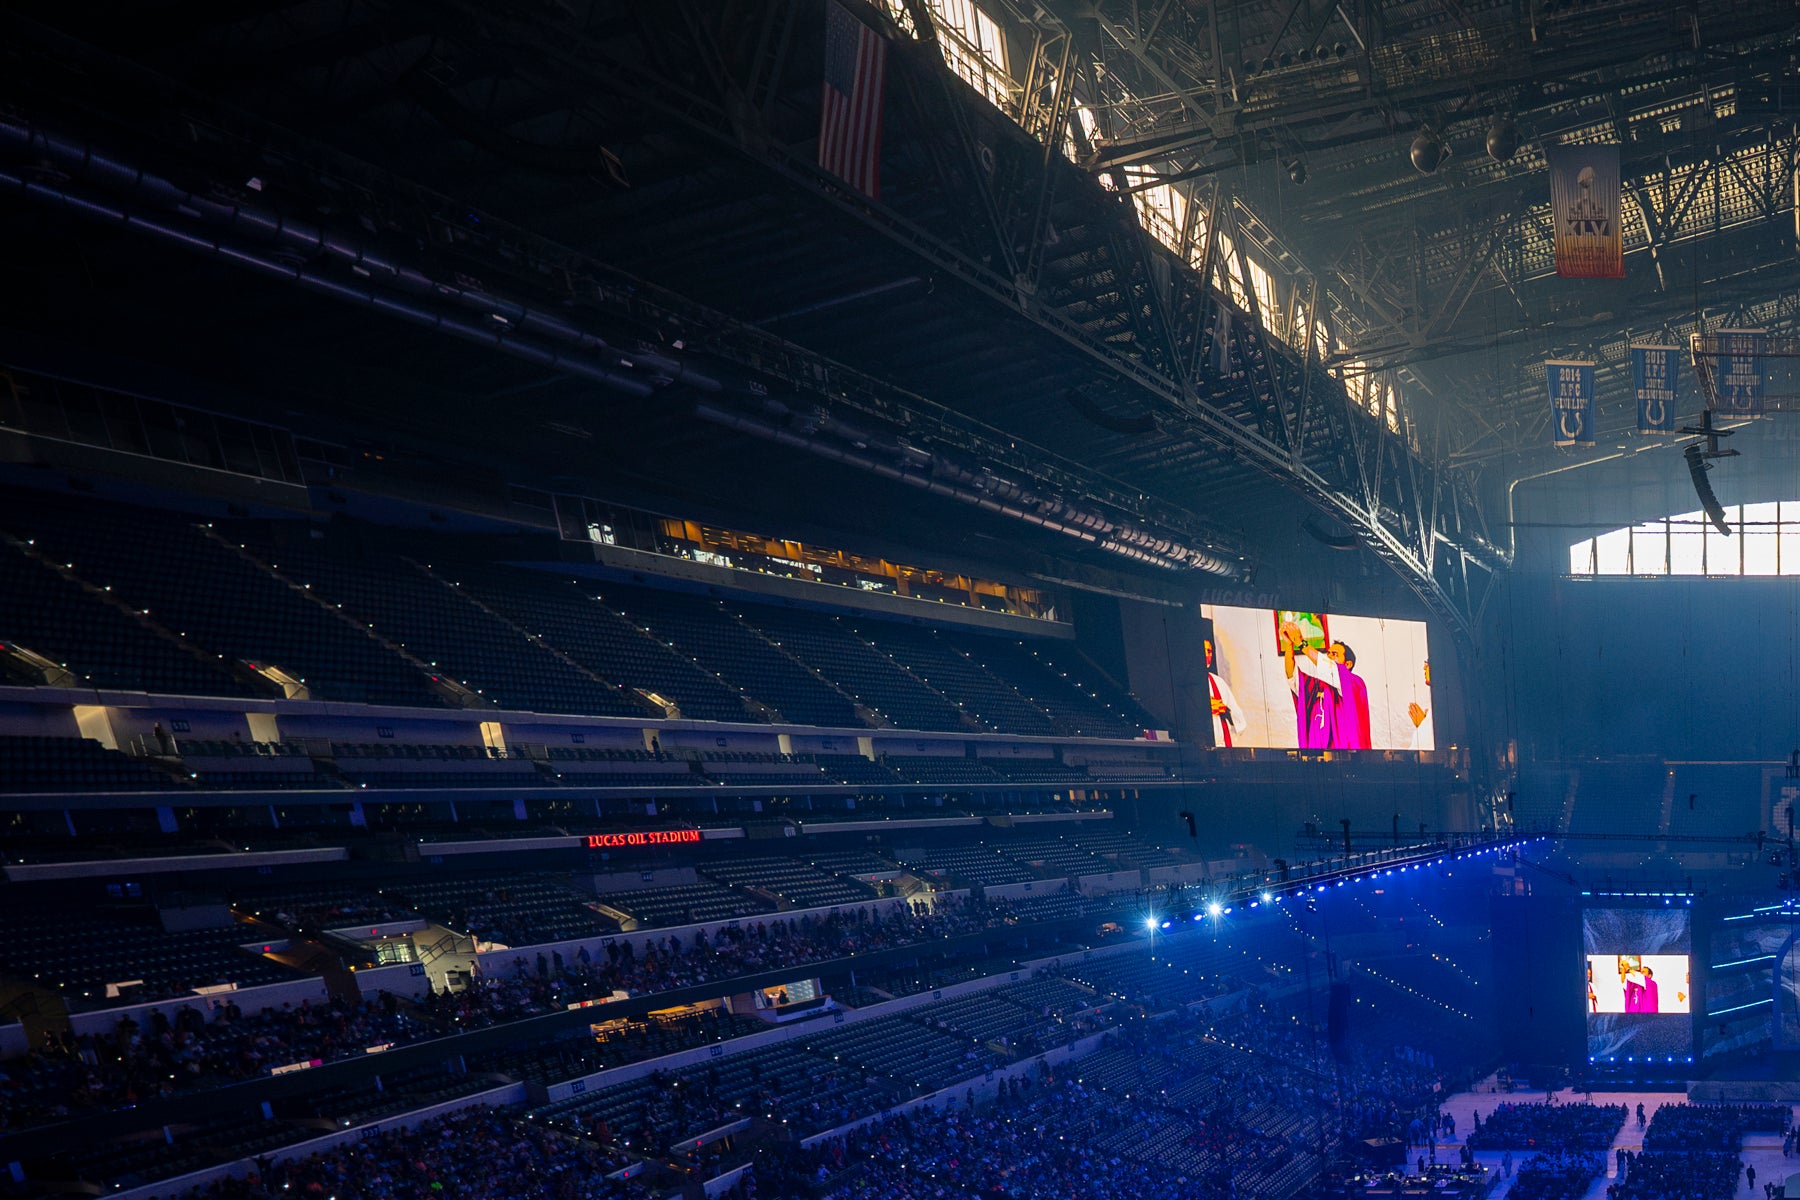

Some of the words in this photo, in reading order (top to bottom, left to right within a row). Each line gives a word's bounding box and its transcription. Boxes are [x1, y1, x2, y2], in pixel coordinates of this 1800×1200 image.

[1645, 351, 1666, 364] 2013
[1560, 368, 1581, 382] 2014
[1645, 364, 1666, 378] AFC
[1561, 383, 1581, 397] AFC
[1201, 588, 1254, 607] LUCAS
[1257, 592, 1281, 608] OIL
[588, 834, 625, 848] LUCAS
[627, 832, 647, 845] OIL
[648, 830, 700, 844] STADIUM
